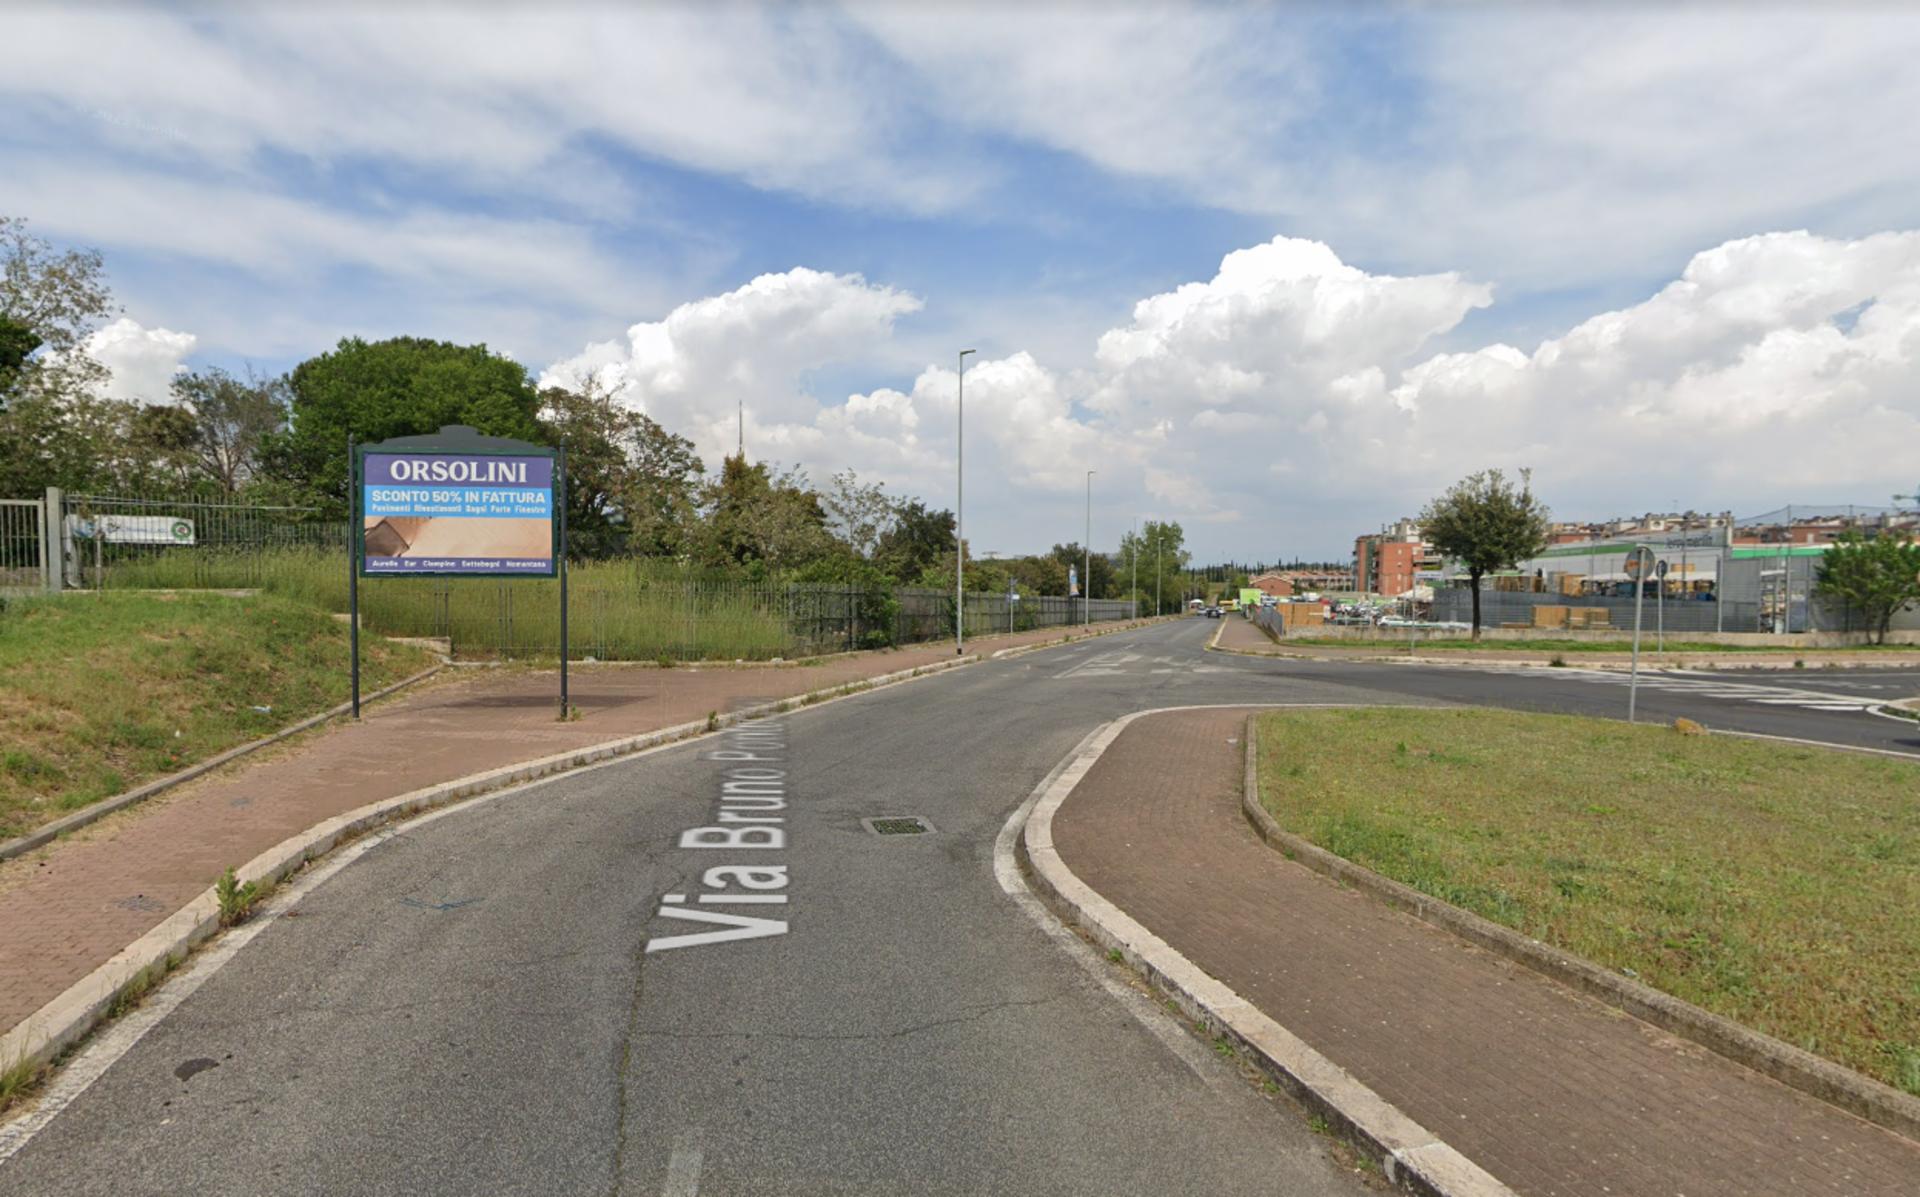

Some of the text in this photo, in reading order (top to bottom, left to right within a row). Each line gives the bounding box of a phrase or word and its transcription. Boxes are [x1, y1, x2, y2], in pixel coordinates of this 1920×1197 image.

[390, 459, 528, 483] ORSOLINI
[372, 490, 545, 504] SCONTO 50% IN FATTURA
